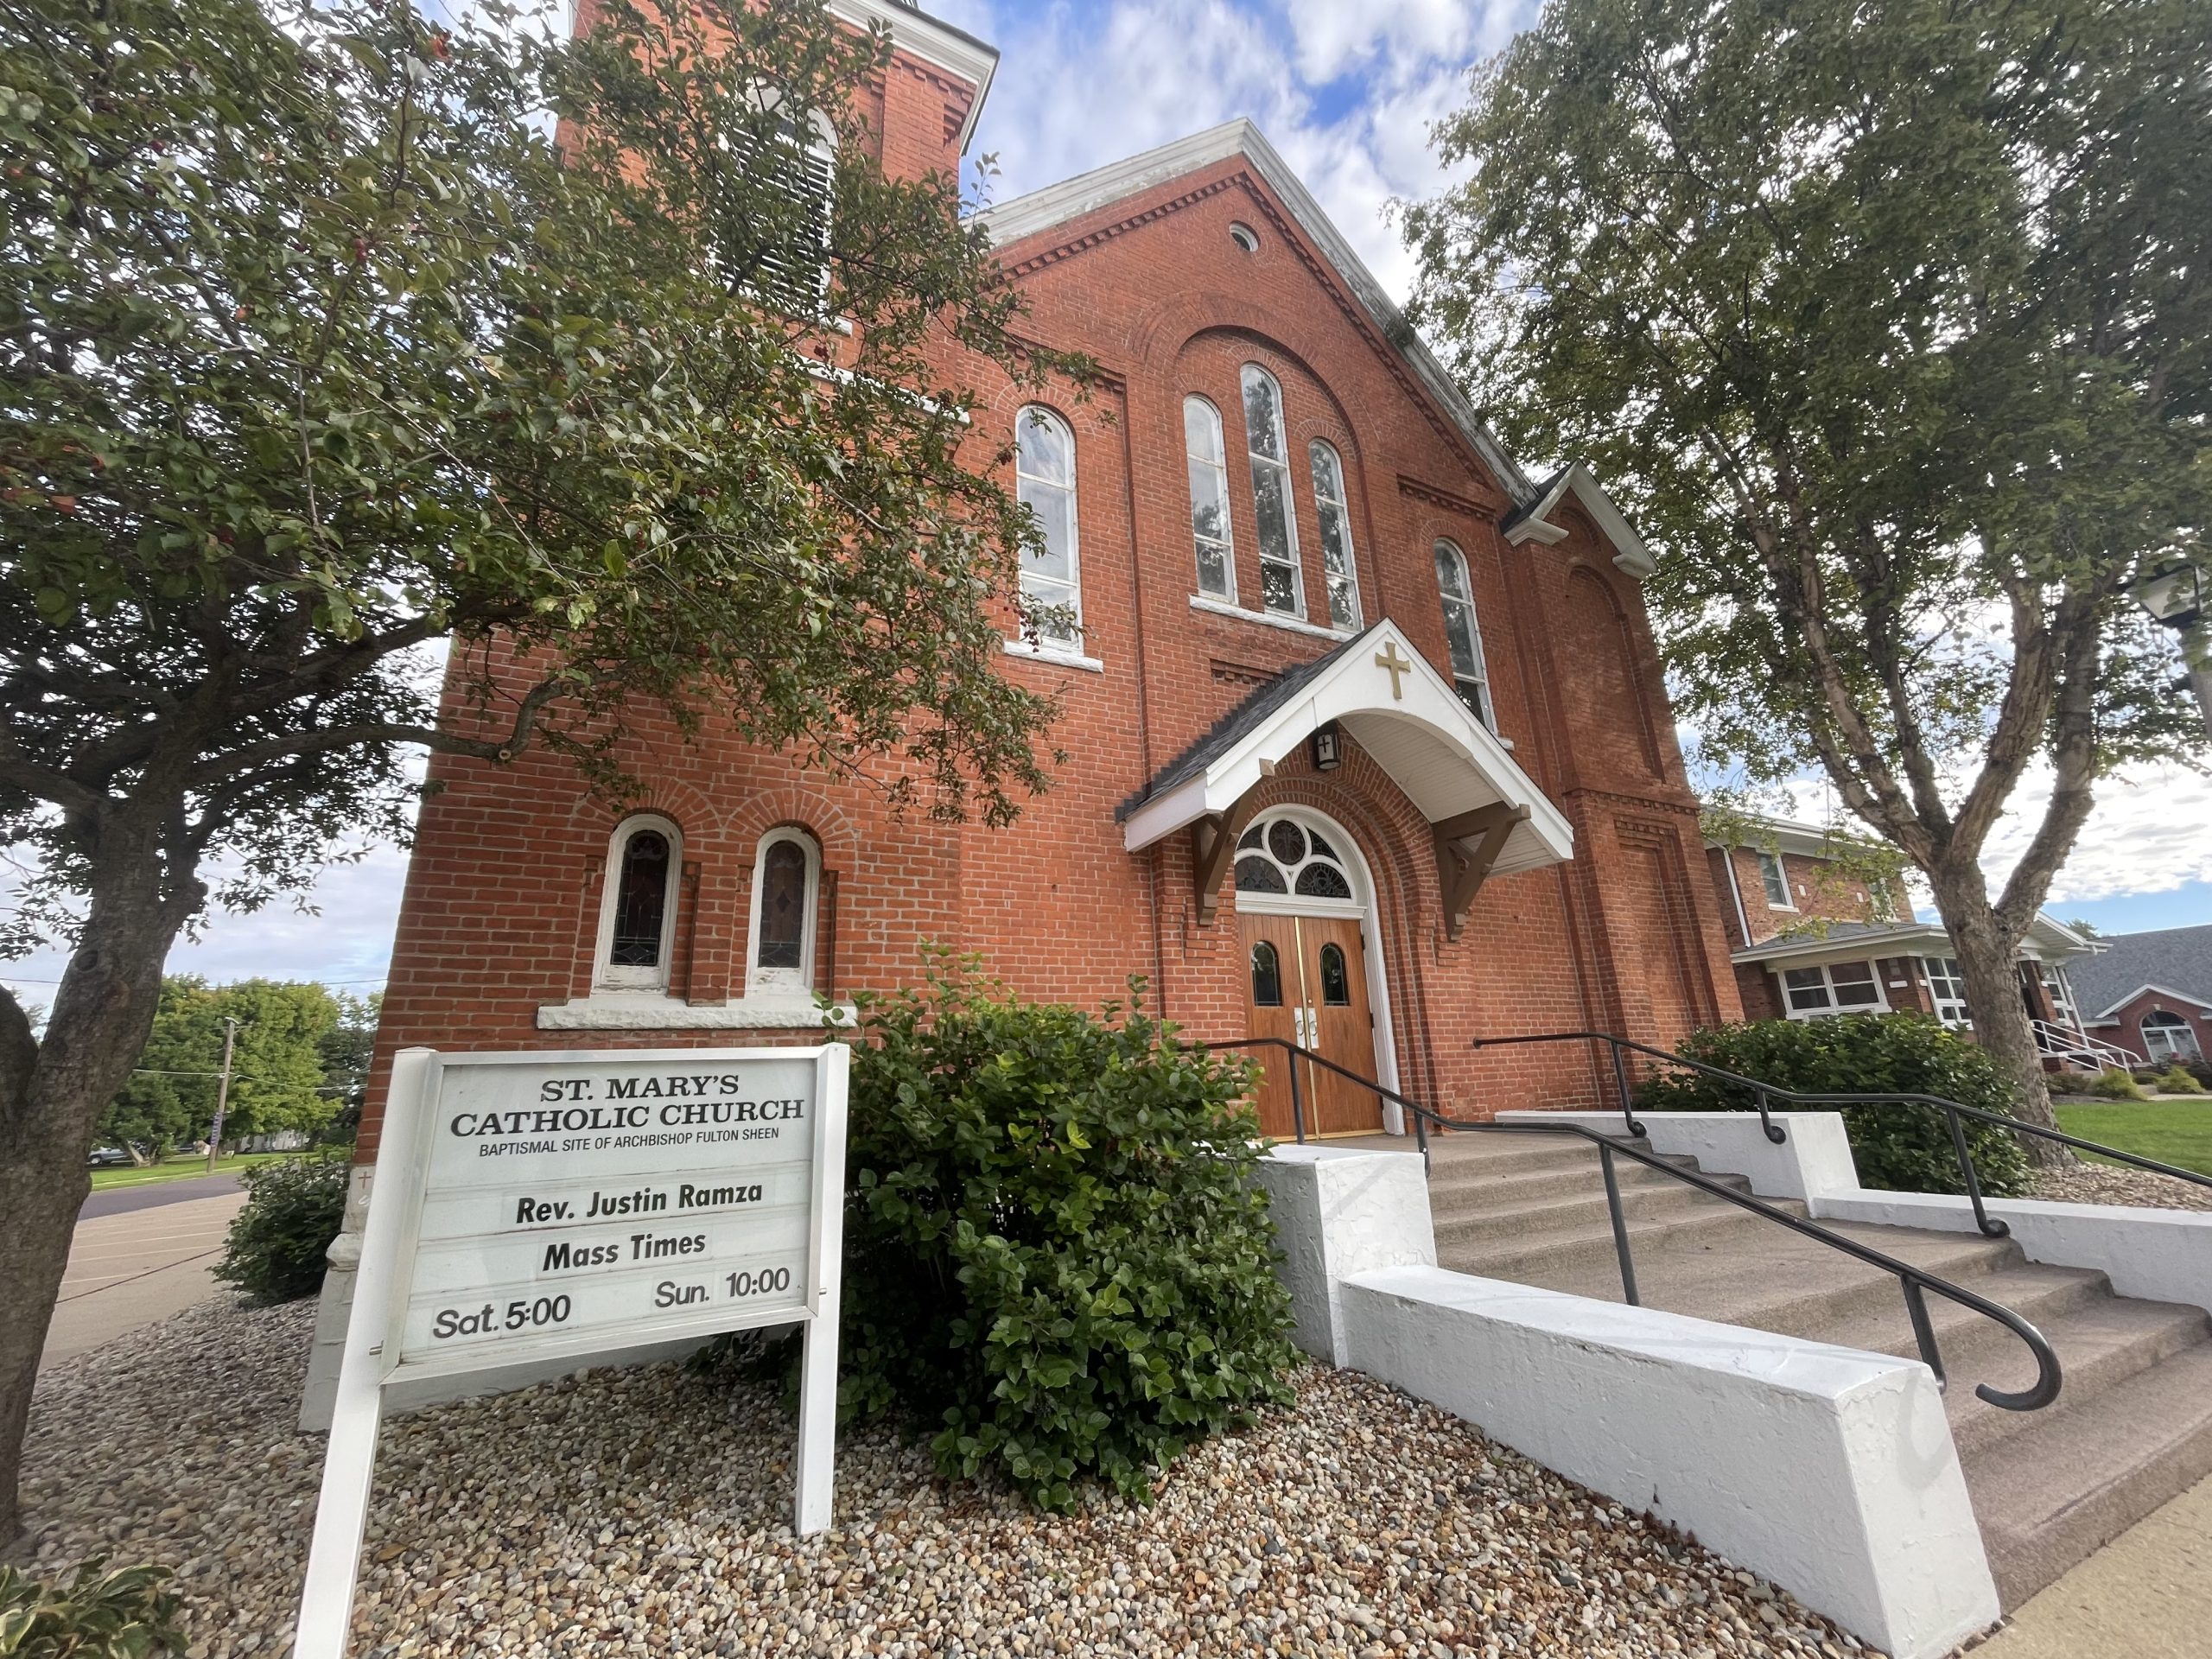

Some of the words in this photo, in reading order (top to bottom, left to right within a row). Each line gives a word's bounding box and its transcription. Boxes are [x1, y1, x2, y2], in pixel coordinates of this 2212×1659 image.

[540, 1079, 594, 1103] ST.
[604, 1074, 740, 1100] MARY'S
[450, 1105, 650, 1137] CATHOLIC
[659, 1098, 805, 1127] CHURCH
[479, 1136, 559, 1158] BAPTISMAL
[562, 1137, 592, 1152] SITE
[594, 1135, 613, 1150] OF
[613, 1132, 694, 1149] ARCHBISHOP
[696, 1129, 740, 1144] FULTON
[741, 1127, 779, 1141] SHEEN
[515, 1197, 575, 1224] Rev.
[586, 1186, 667, 1218] Justin
[678, 1180, 763, 1209] Ramza
[542, 1243, 620, 1272] Mass
[630, 1233, 707, 1262] Times
[654, 1280, 710, 1308] Sun.
[725, 1267, 791, 1298] 10:00
